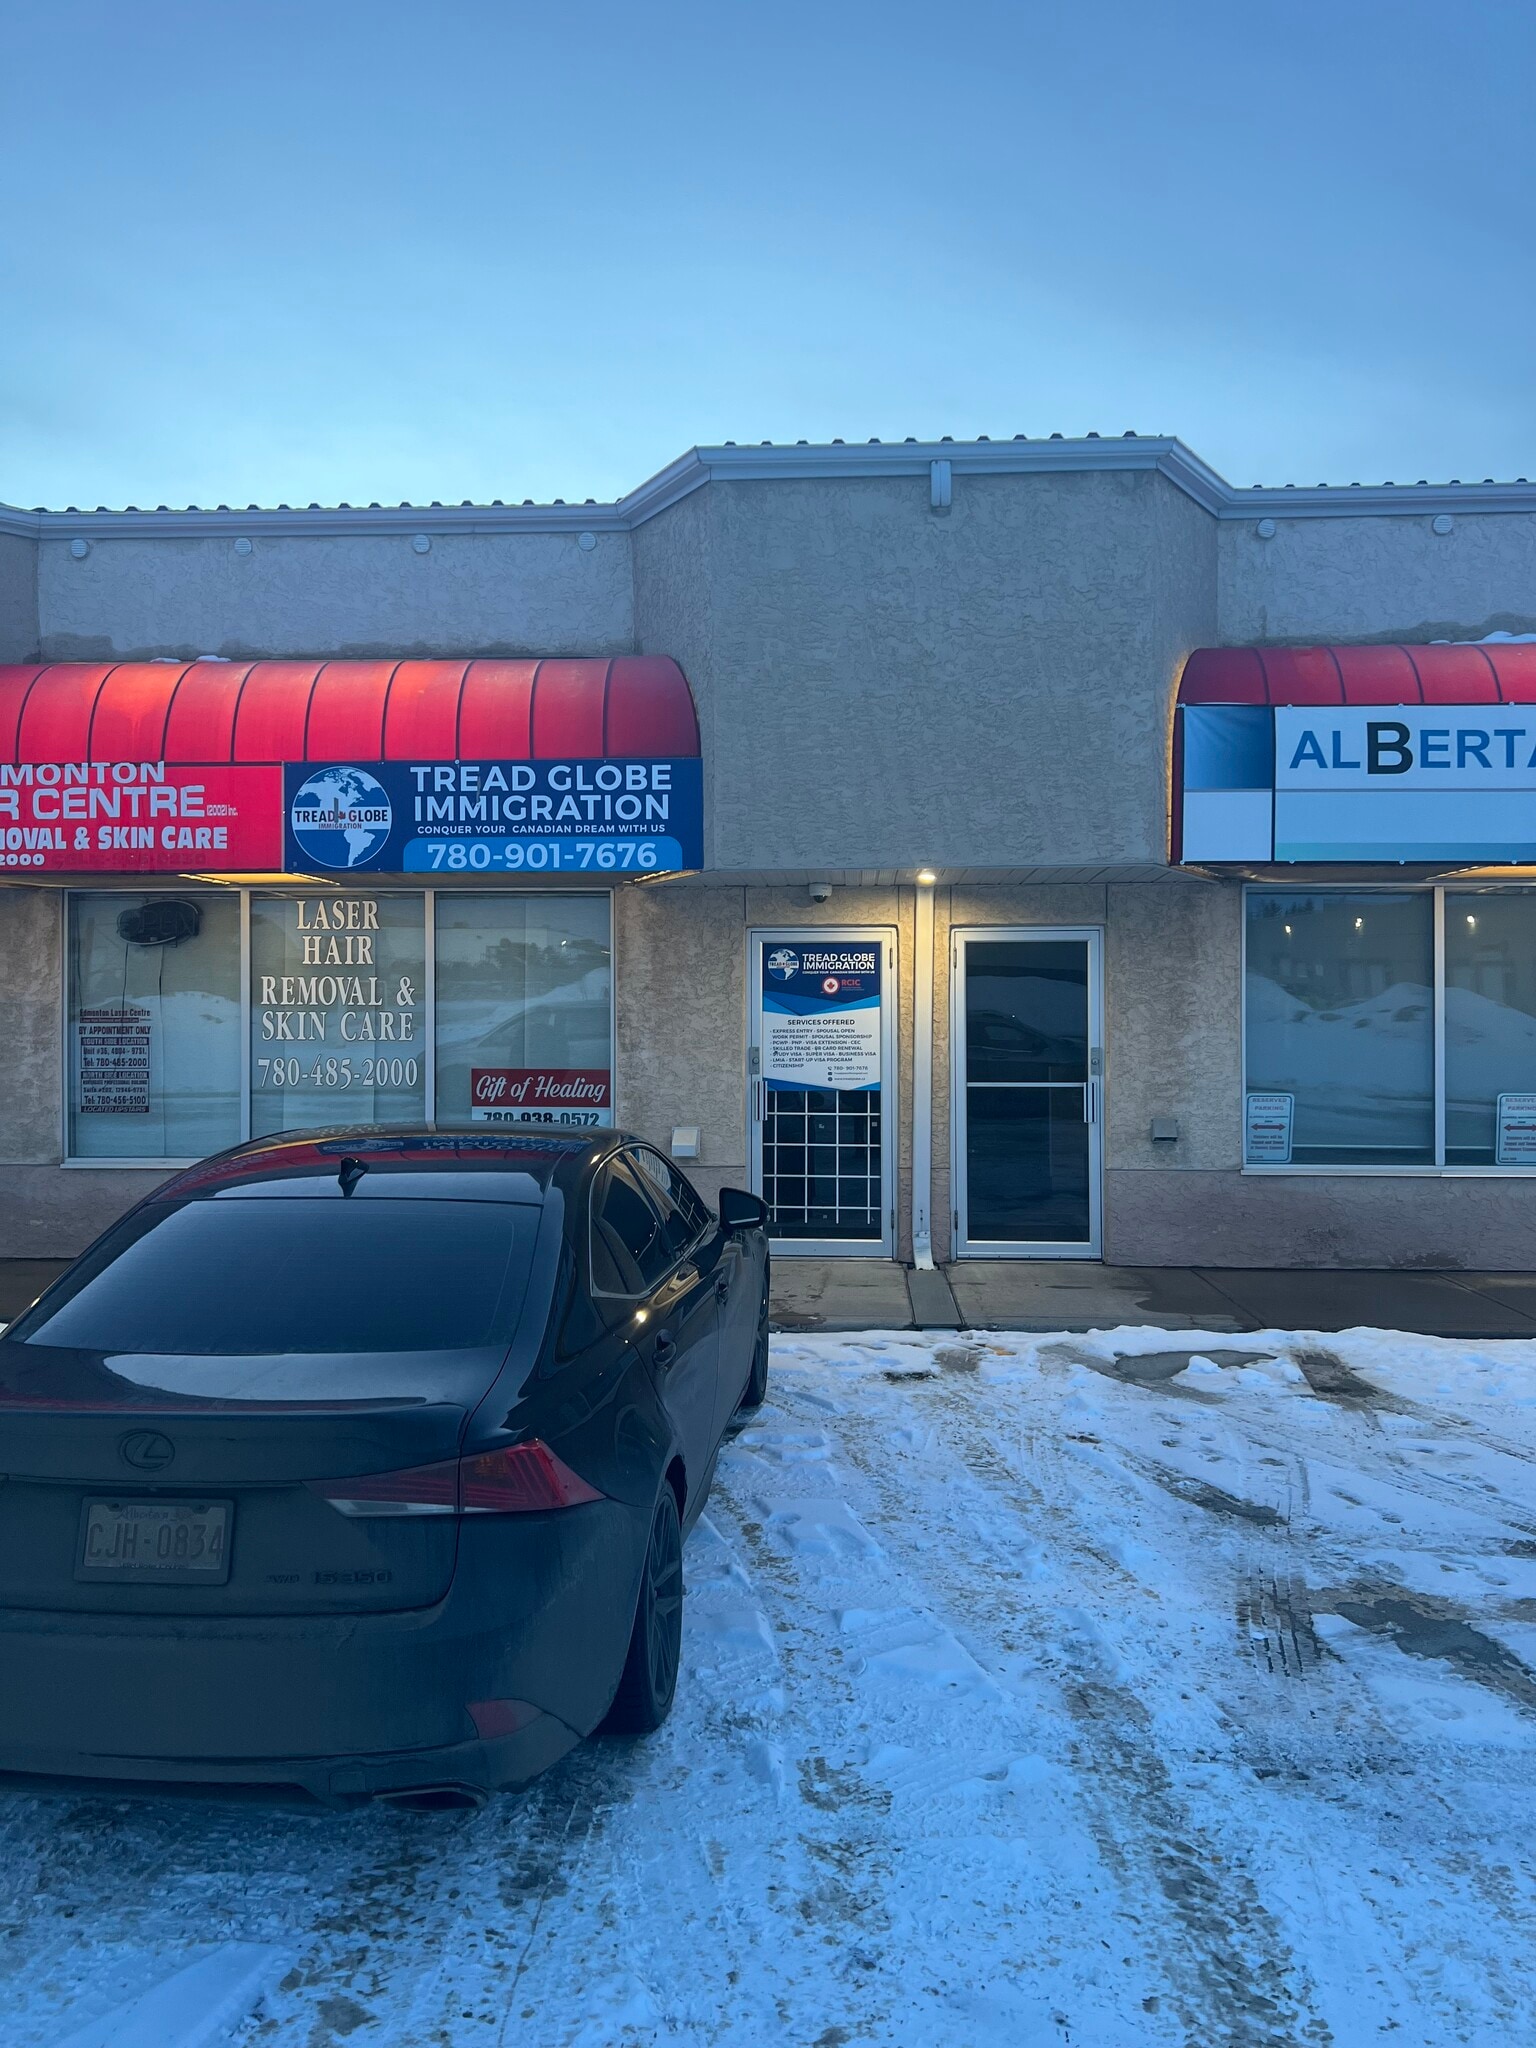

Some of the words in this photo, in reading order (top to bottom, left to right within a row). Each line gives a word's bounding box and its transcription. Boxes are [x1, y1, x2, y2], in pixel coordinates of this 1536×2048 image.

[1289, 721, 1536, 775] ALBERT
[1, 761, 165, 786] MONTON
[410, 765, 536, 792] TREAD
[547, 764, 672, 791] GLOBE
[32, 785, 205, 820] CENTRE
[295, 811, 336, 822] TREAD
[349, 810, 388, 822] GLOBE
[414, 794, 669, 821] IMMIGRATION
[0, 827, 67, 850] OVAL
[74, 826, 90, 850] &
[98, 826, 154, 849] SKIN
[161, 825, 228, 849] CARE
[417, 825, 472, 835] CONQUER
[475, 825, 506, 834] YOUR
[512, 825, 573, 834] CANADIAN
[575, 825, 615, 833] DREAM
[618, 824, 647, 833] WITH
[650, 824, 666, 832] US
[427, 842, 657, 869] 780-901-7676
[296, 900, 380, 930] LASER
[302, 935, 373, 965] HAIR
[802, 953, 838, 962] TREAD
[840, 953, 875, 962] GLOBE
[803, 962, 875, 970] IMMIGRATION
[260, 976, 383, 1006] REMOVAL
[396, 976, 415, 1006] &
[80, 1009, 109, 1017] Edmonton
[129, 1009, 150, 1017] Centre
[262, 1011, 327, 1041] SKIN
[340, 1011, 414, 1041] CARE
[79, 1026, 87, 1035] BY
[89, 1026, 134, 1035] APPOINTMENT
[136, 1026, 151, 1035] ONLY
[96, 1058, 147, 1067] 780-485-2000
[257, 1054, 418, 1090] 780-485-2000
[97, 1095, 147, 1104] 780-456-5100
[476, 1075, 507, 1102] Gift
[510, 1077, 534, 1102] of
[534, 1076, 606, 1103] Healing
[88, 1522, 223, 1560] CJH-0834
